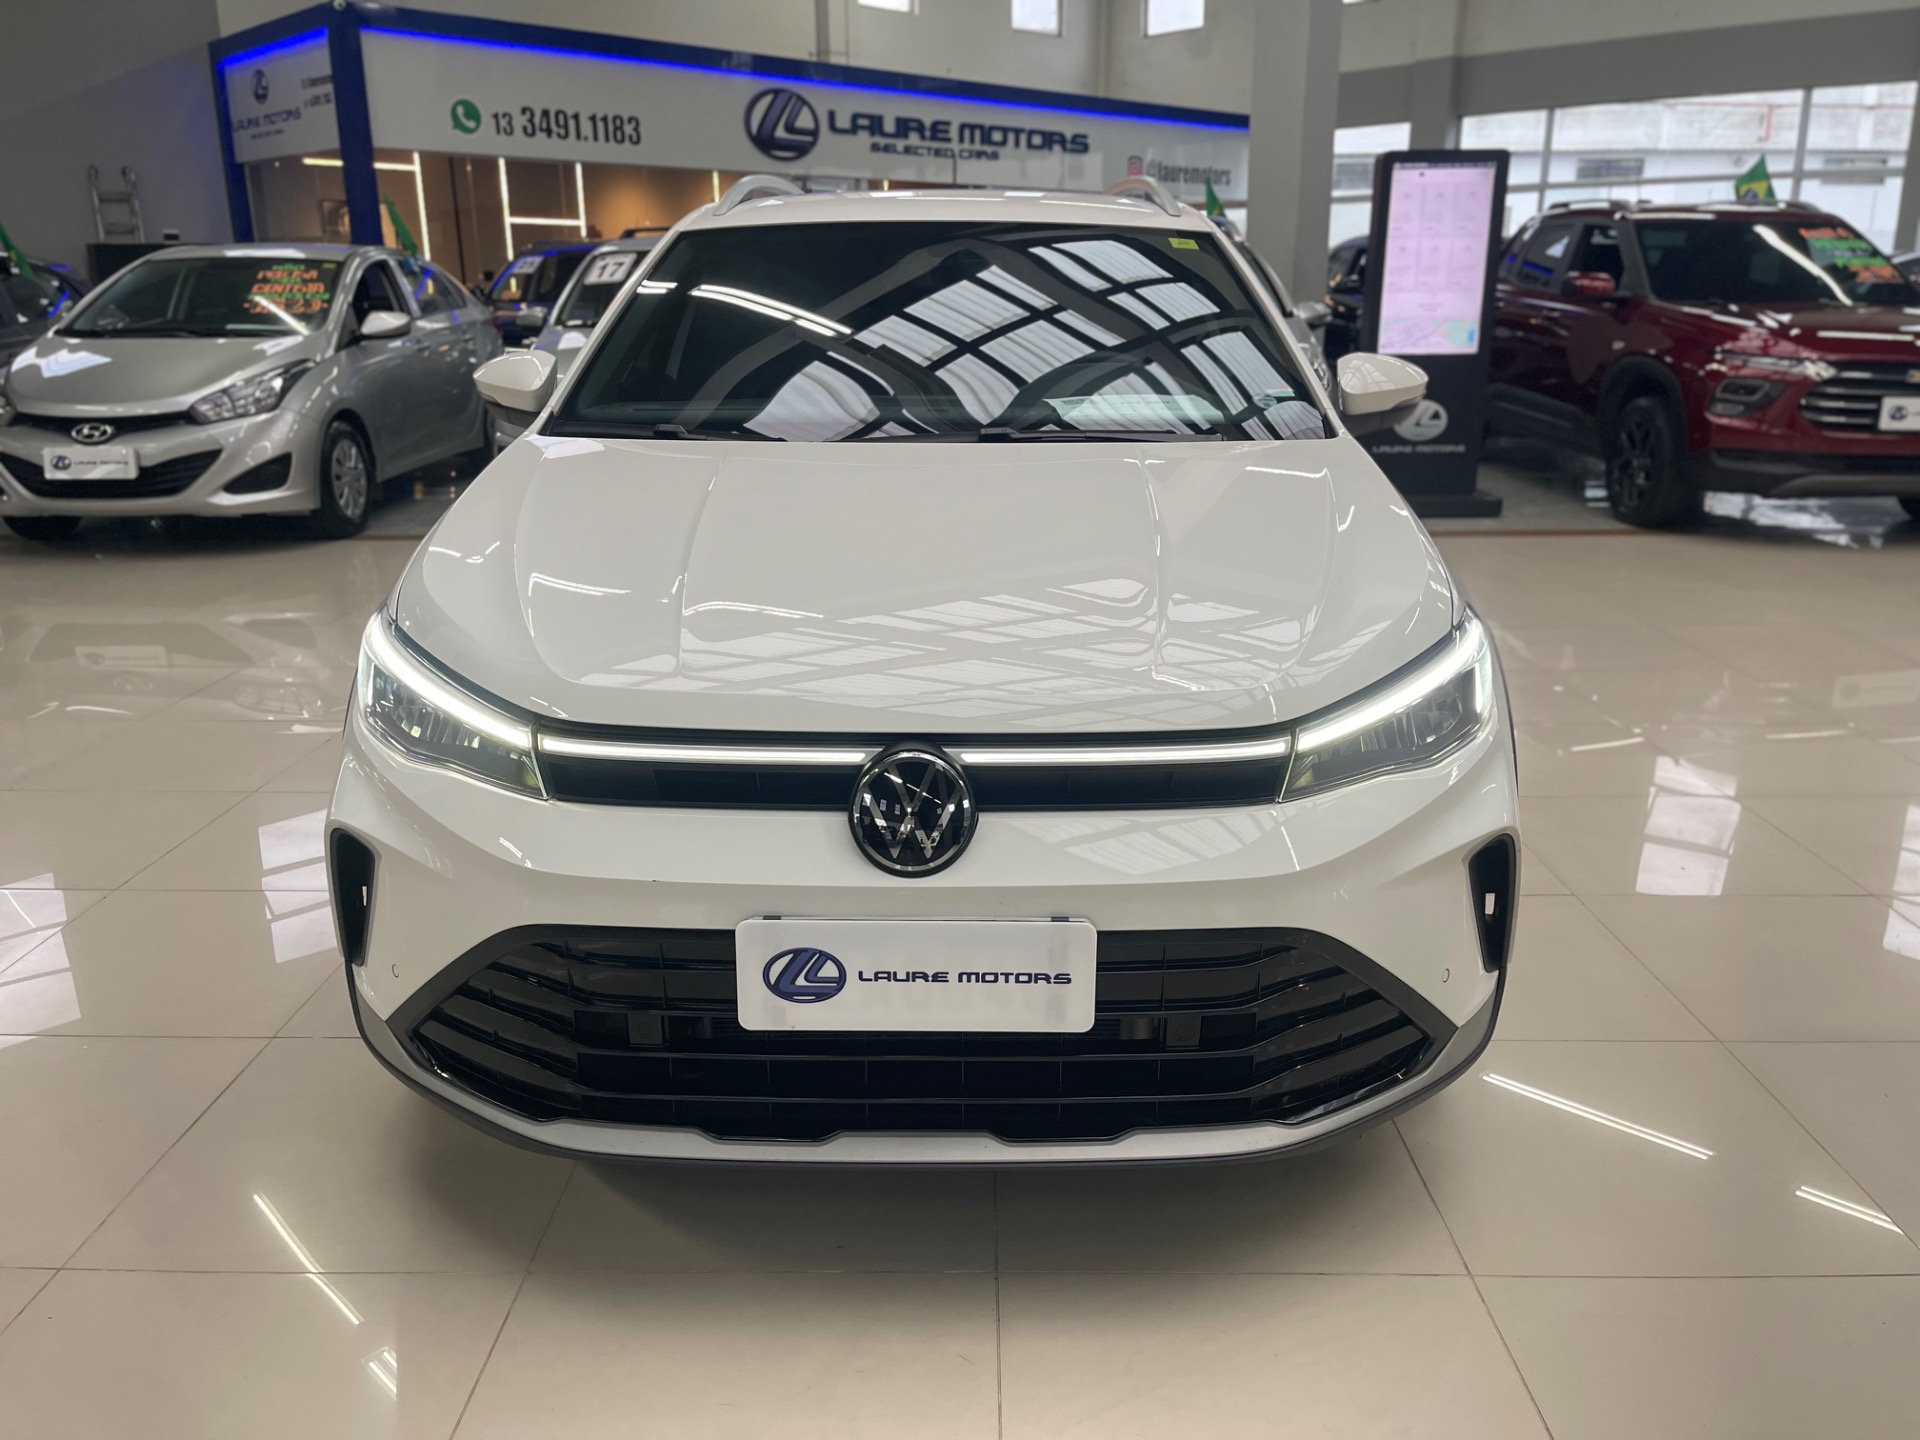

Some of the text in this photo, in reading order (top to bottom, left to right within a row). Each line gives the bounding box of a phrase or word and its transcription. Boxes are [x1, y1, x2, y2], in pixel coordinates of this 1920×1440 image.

[491, 106, 641, 146] 13 3491.1183
[828, 109, 1090, 154] LAURE MOTORS
[870, 142, 1001, 160] SELECTED CARS
[597, 261, 625, 279] 17
[858, 970, 1072, 985] LAURE MOTORS
